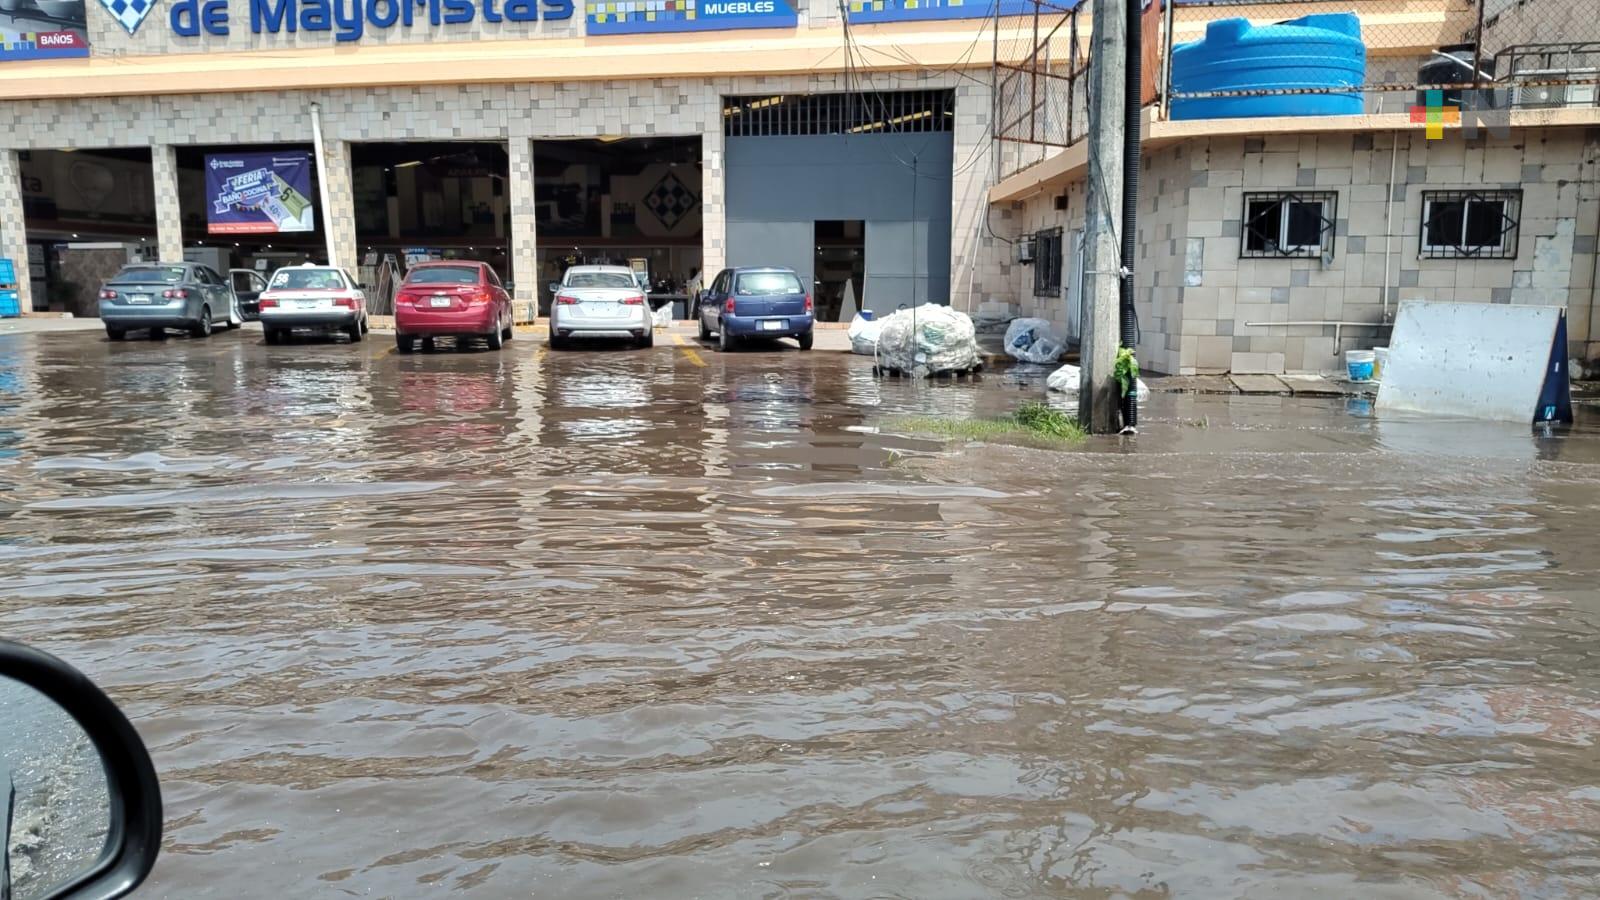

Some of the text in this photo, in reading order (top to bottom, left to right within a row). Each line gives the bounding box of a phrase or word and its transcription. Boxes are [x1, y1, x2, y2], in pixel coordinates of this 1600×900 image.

[704, 1, 775, 15] MUEBLES
[170, 0, 574, 42] de Mayoristas
[41, 33, 73, 45] BAÑOS
